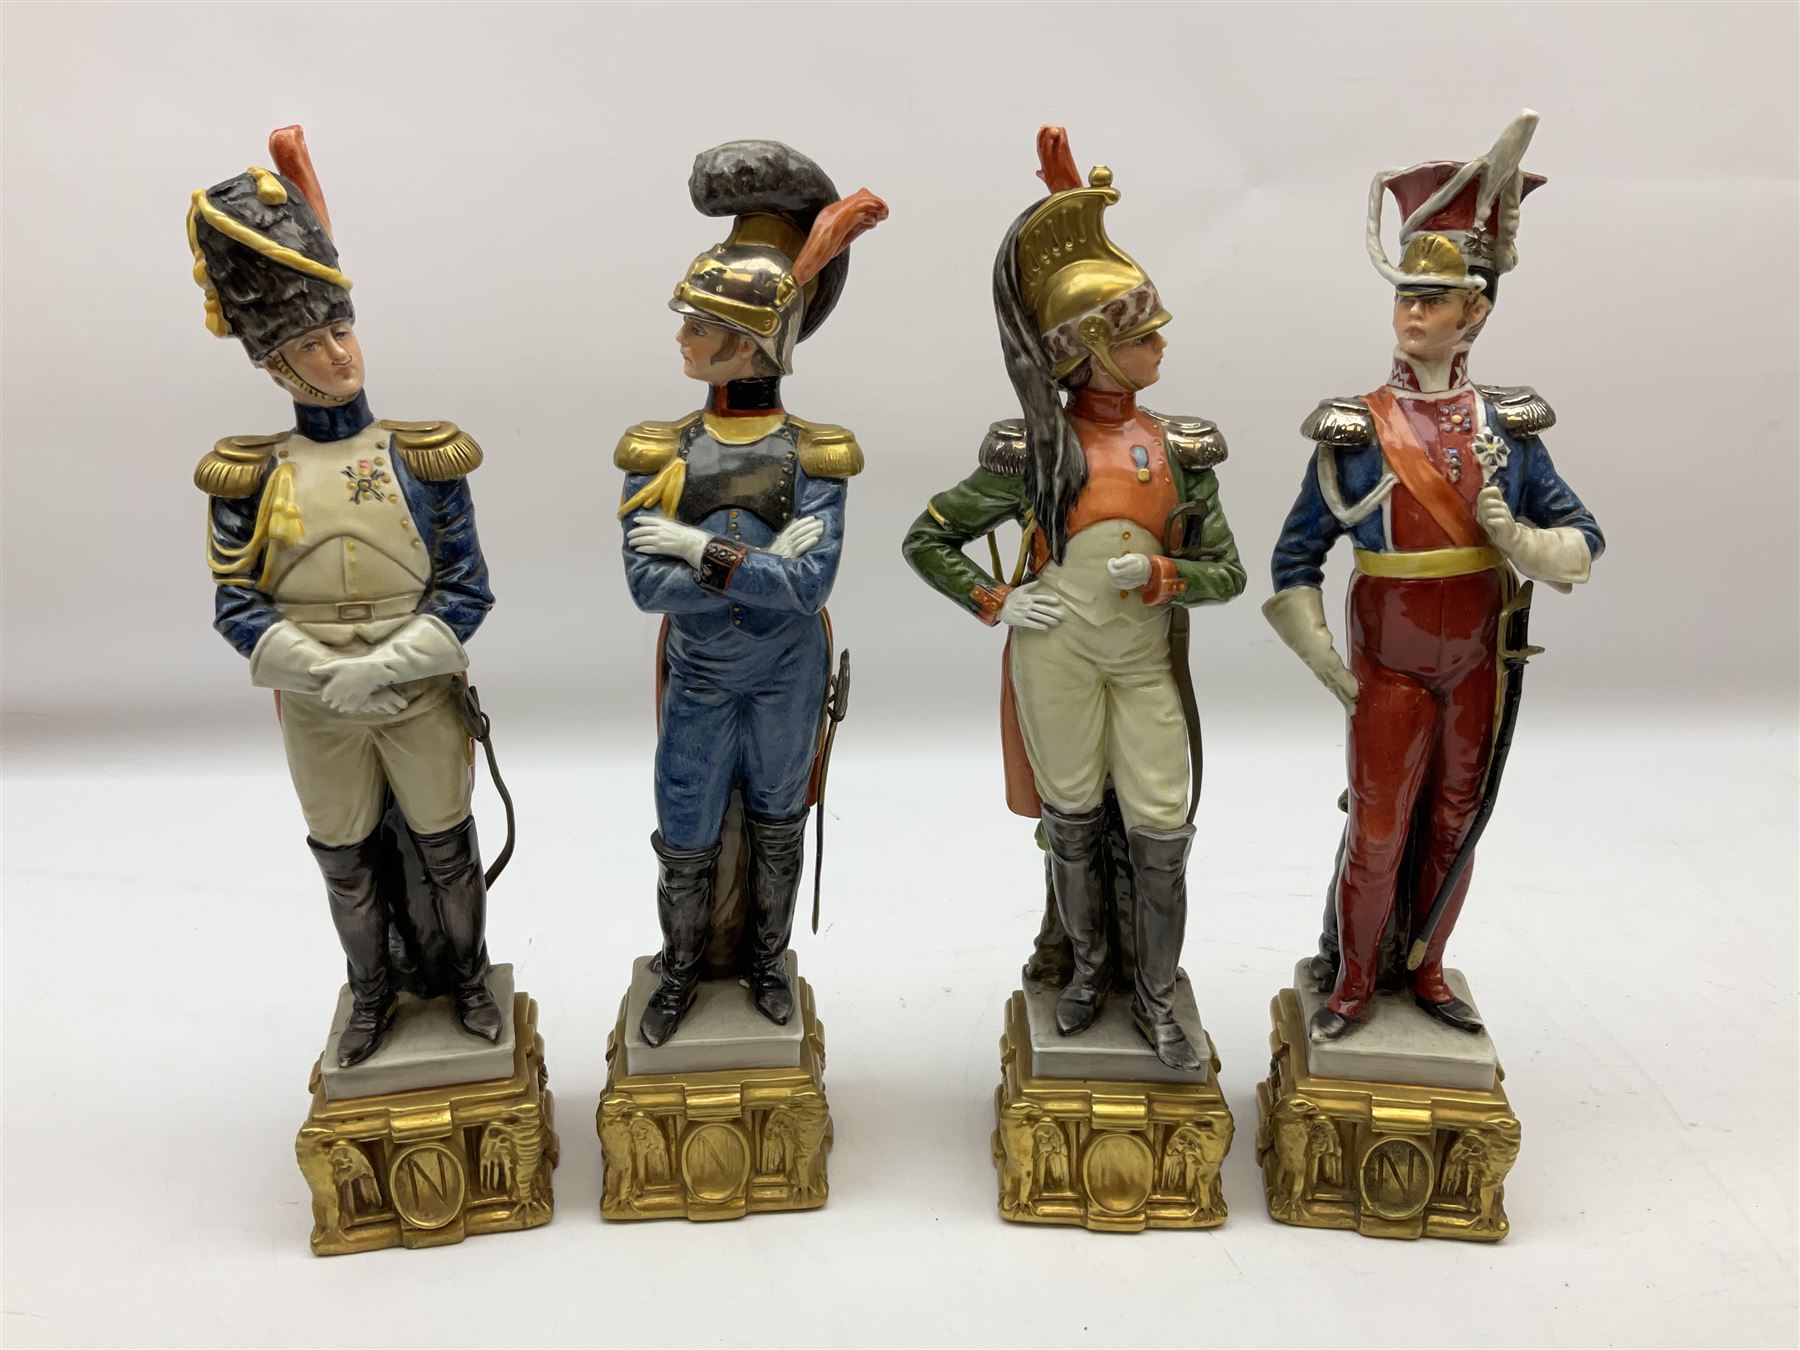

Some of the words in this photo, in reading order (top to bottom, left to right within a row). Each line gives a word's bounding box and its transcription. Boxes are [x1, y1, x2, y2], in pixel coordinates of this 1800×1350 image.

[406, 1151, 448, 1209] N
[698, 1134, 734, 1178] N
[1377, 1149, 1415, 1197] N
